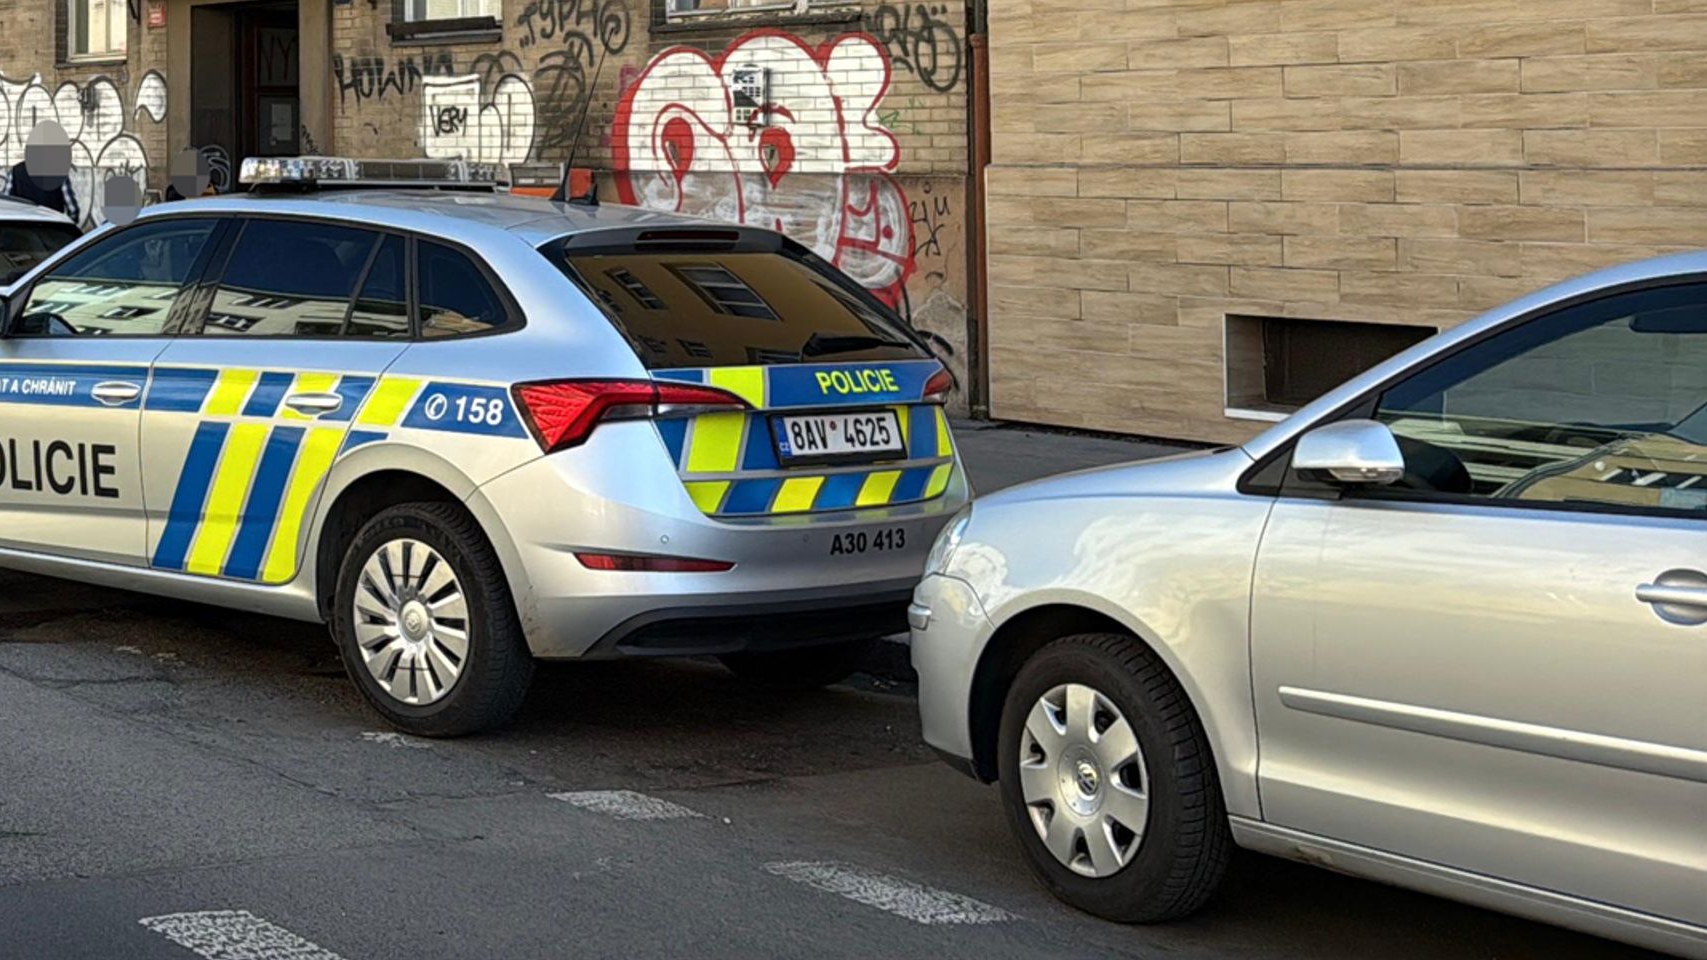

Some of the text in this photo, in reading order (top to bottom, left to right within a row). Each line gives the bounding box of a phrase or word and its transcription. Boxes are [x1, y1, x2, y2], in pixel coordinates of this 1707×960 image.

[9, 380, 19, 394] A
[22, 376, 76, 396] CHRÁNIT
[814, 369, 900, 395] POLICIE
[455, 395, 504, 426] 158
[791, 416, 891, 450] 8AV 4625
[830, 528, 906, 556] A30 413
